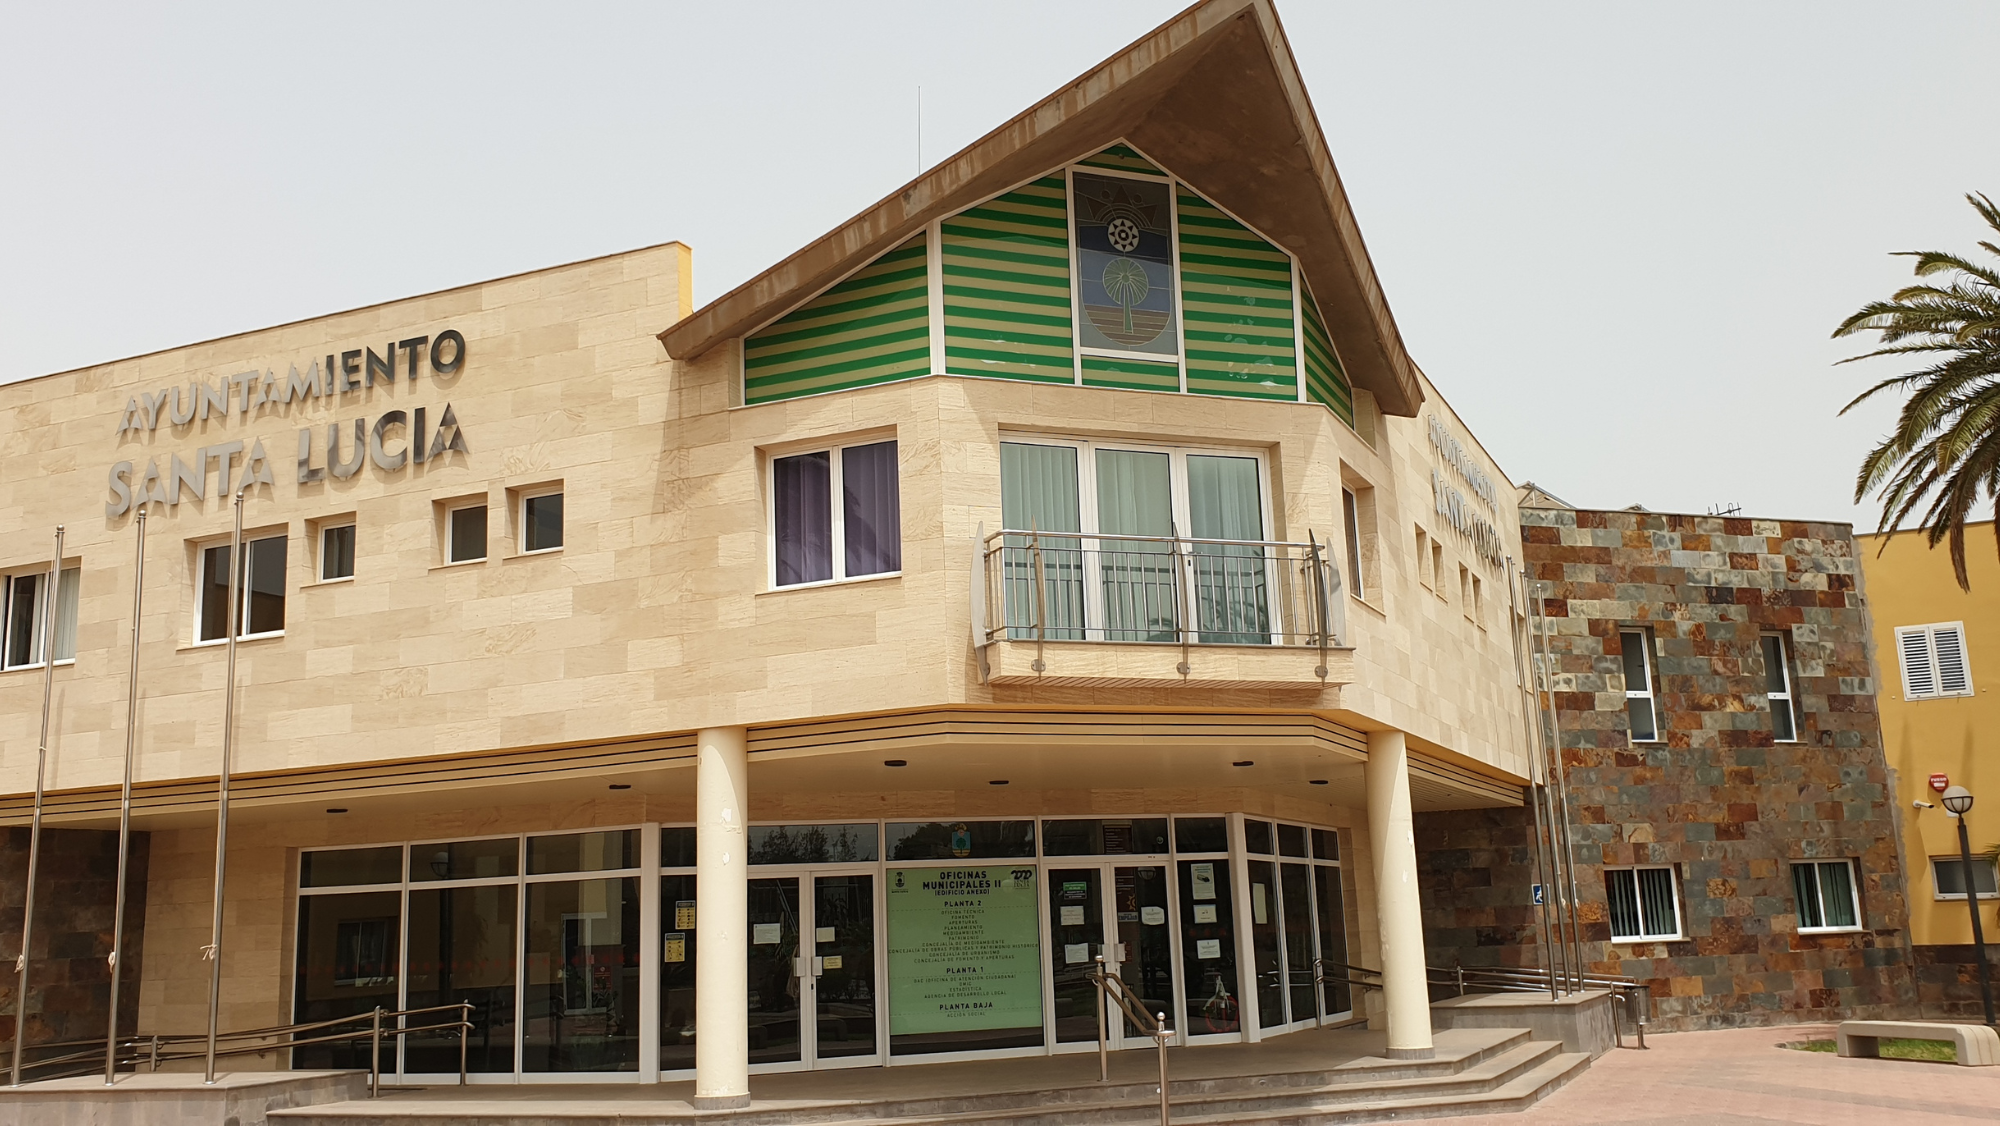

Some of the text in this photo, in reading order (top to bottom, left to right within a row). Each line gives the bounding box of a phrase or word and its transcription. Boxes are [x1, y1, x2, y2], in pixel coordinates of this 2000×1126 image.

[116, 328, 467, 435] AYUNTAMIENTO
[104, 401, 470, 519] SANTA LUCIA
[940, 871, 987, 880] OFICINAS
[923, 880, 1002, 890] MUNICIPALES II
[939, 1003, 970, 1011] PLANTA
